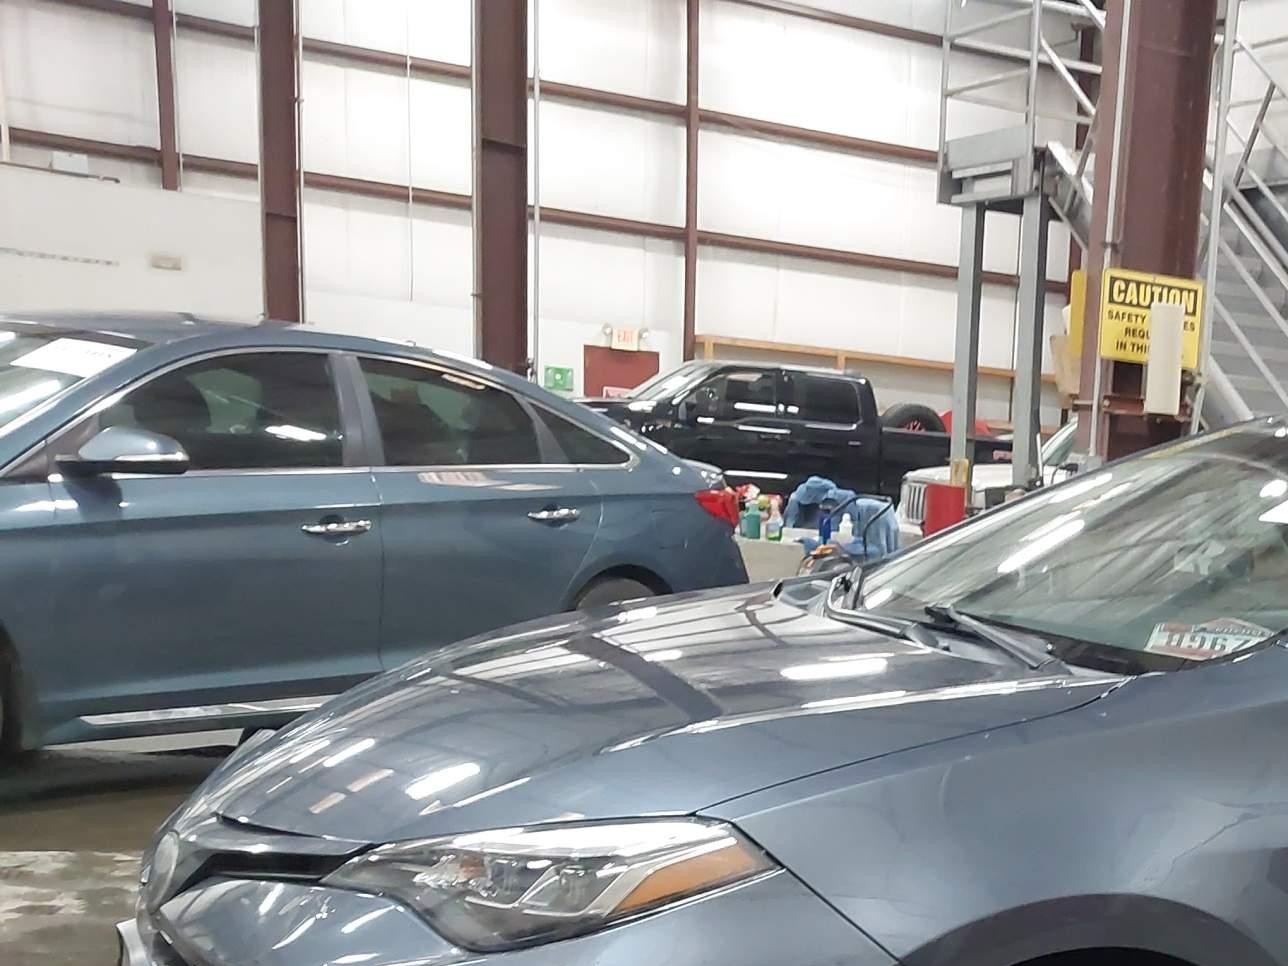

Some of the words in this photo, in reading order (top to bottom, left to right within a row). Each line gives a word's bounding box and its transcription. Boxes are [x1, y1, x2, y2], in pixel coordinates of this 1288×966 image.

[1112, 279, 1195, 314] CAUTION
[1107, 309, 1147, 324] SAFETY
[1124, 327, 1150, 340] REQU
[1115, 340, 1127, 352] IN
[1130, 342, 1150, 354] THI
